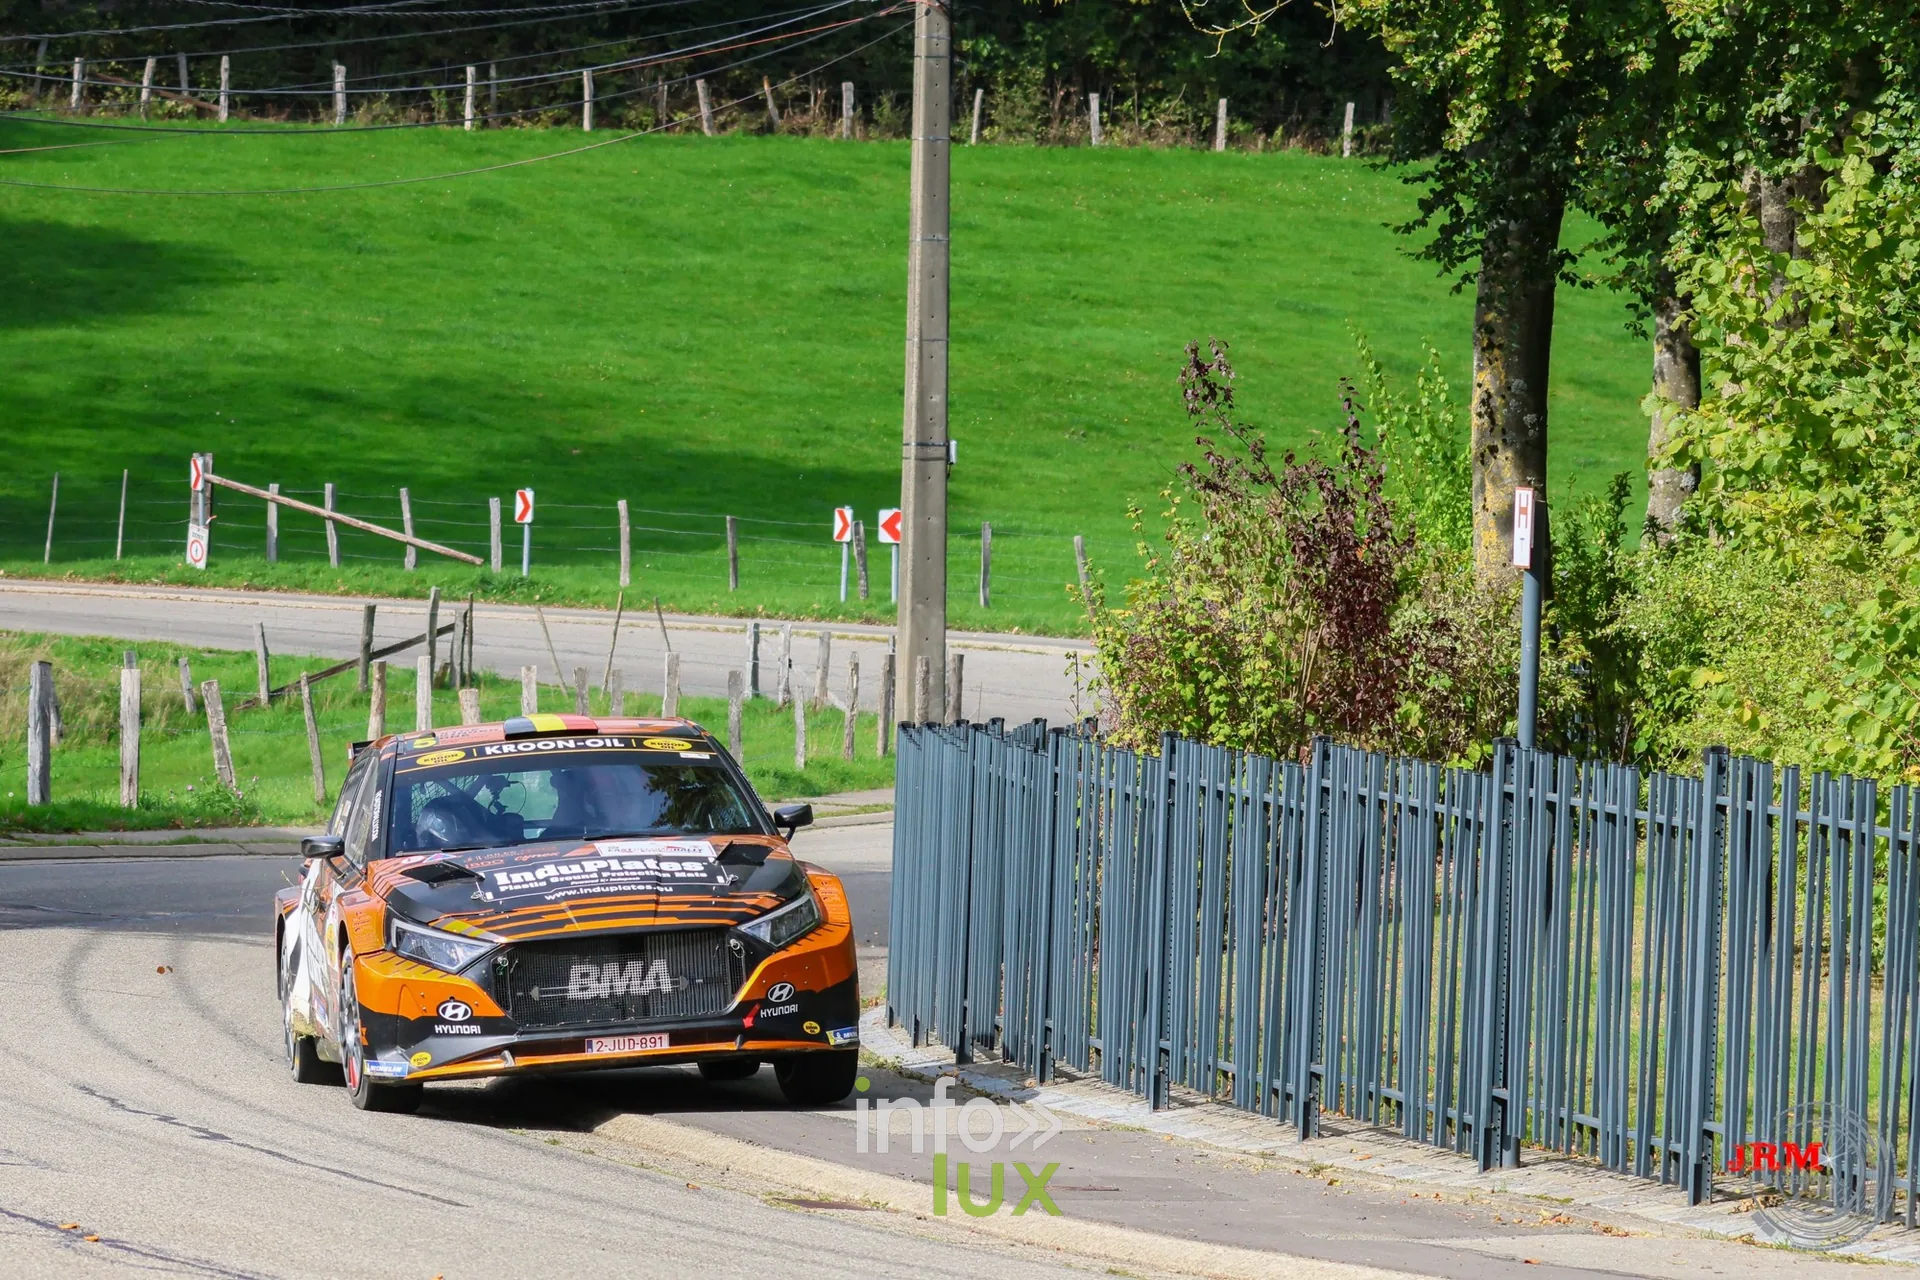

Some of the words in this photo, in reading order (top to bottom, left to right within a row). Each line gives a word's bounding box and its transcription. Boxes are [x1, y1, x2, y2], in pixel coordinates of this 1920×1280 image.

[412, 736, 437, 750] 5
[484, 738, 625, 756] KROON-OIL
[493, 858, 706, 885] InduPlates
[499, 880, 547, 893] Plastic
[550, 871, 598, 883] Ground
[601, 869, 672, 879] Protection
[543, 884, 674, 901] www.induplates.eu
[567, 958, 672, 1000] BMA
[760, 1004, 799, 1018] HYUNDAI
[434, 1024, 482, 1035] HYUNDAI
[595, 1036, 664, 1053] 2-JUD-891
